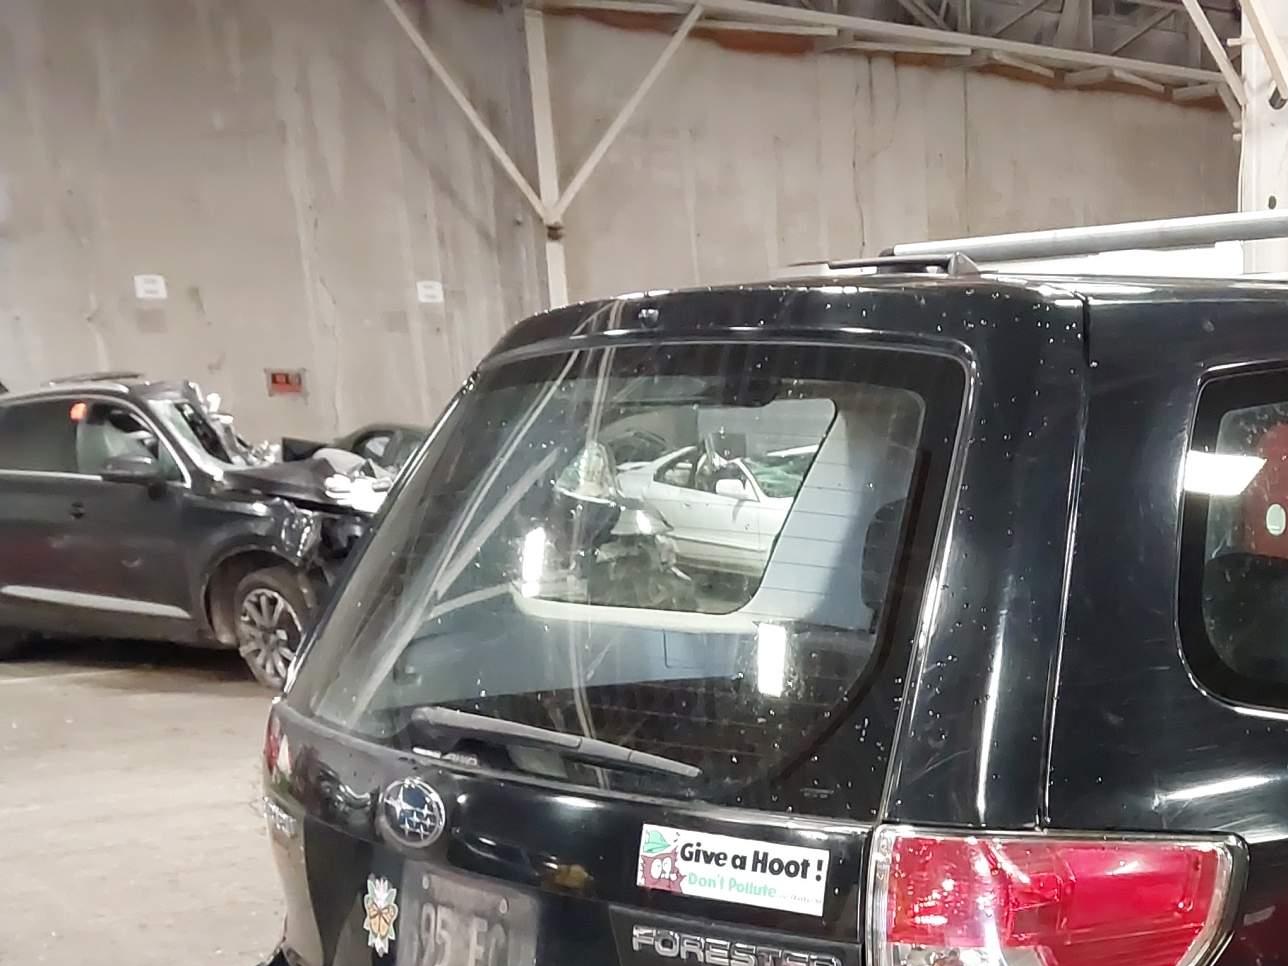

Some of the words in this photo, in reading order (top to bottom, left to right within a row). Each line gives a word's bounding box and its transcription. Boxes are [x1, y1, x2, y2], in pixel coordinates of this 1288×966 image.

[680, 842, 728, 867] Give
[731, 853, 747, 871] a
[751, 850, 810, 880] Hoot
[687, 872, 725, 891] Don't
[728, 877, 777, 898] Pollute
